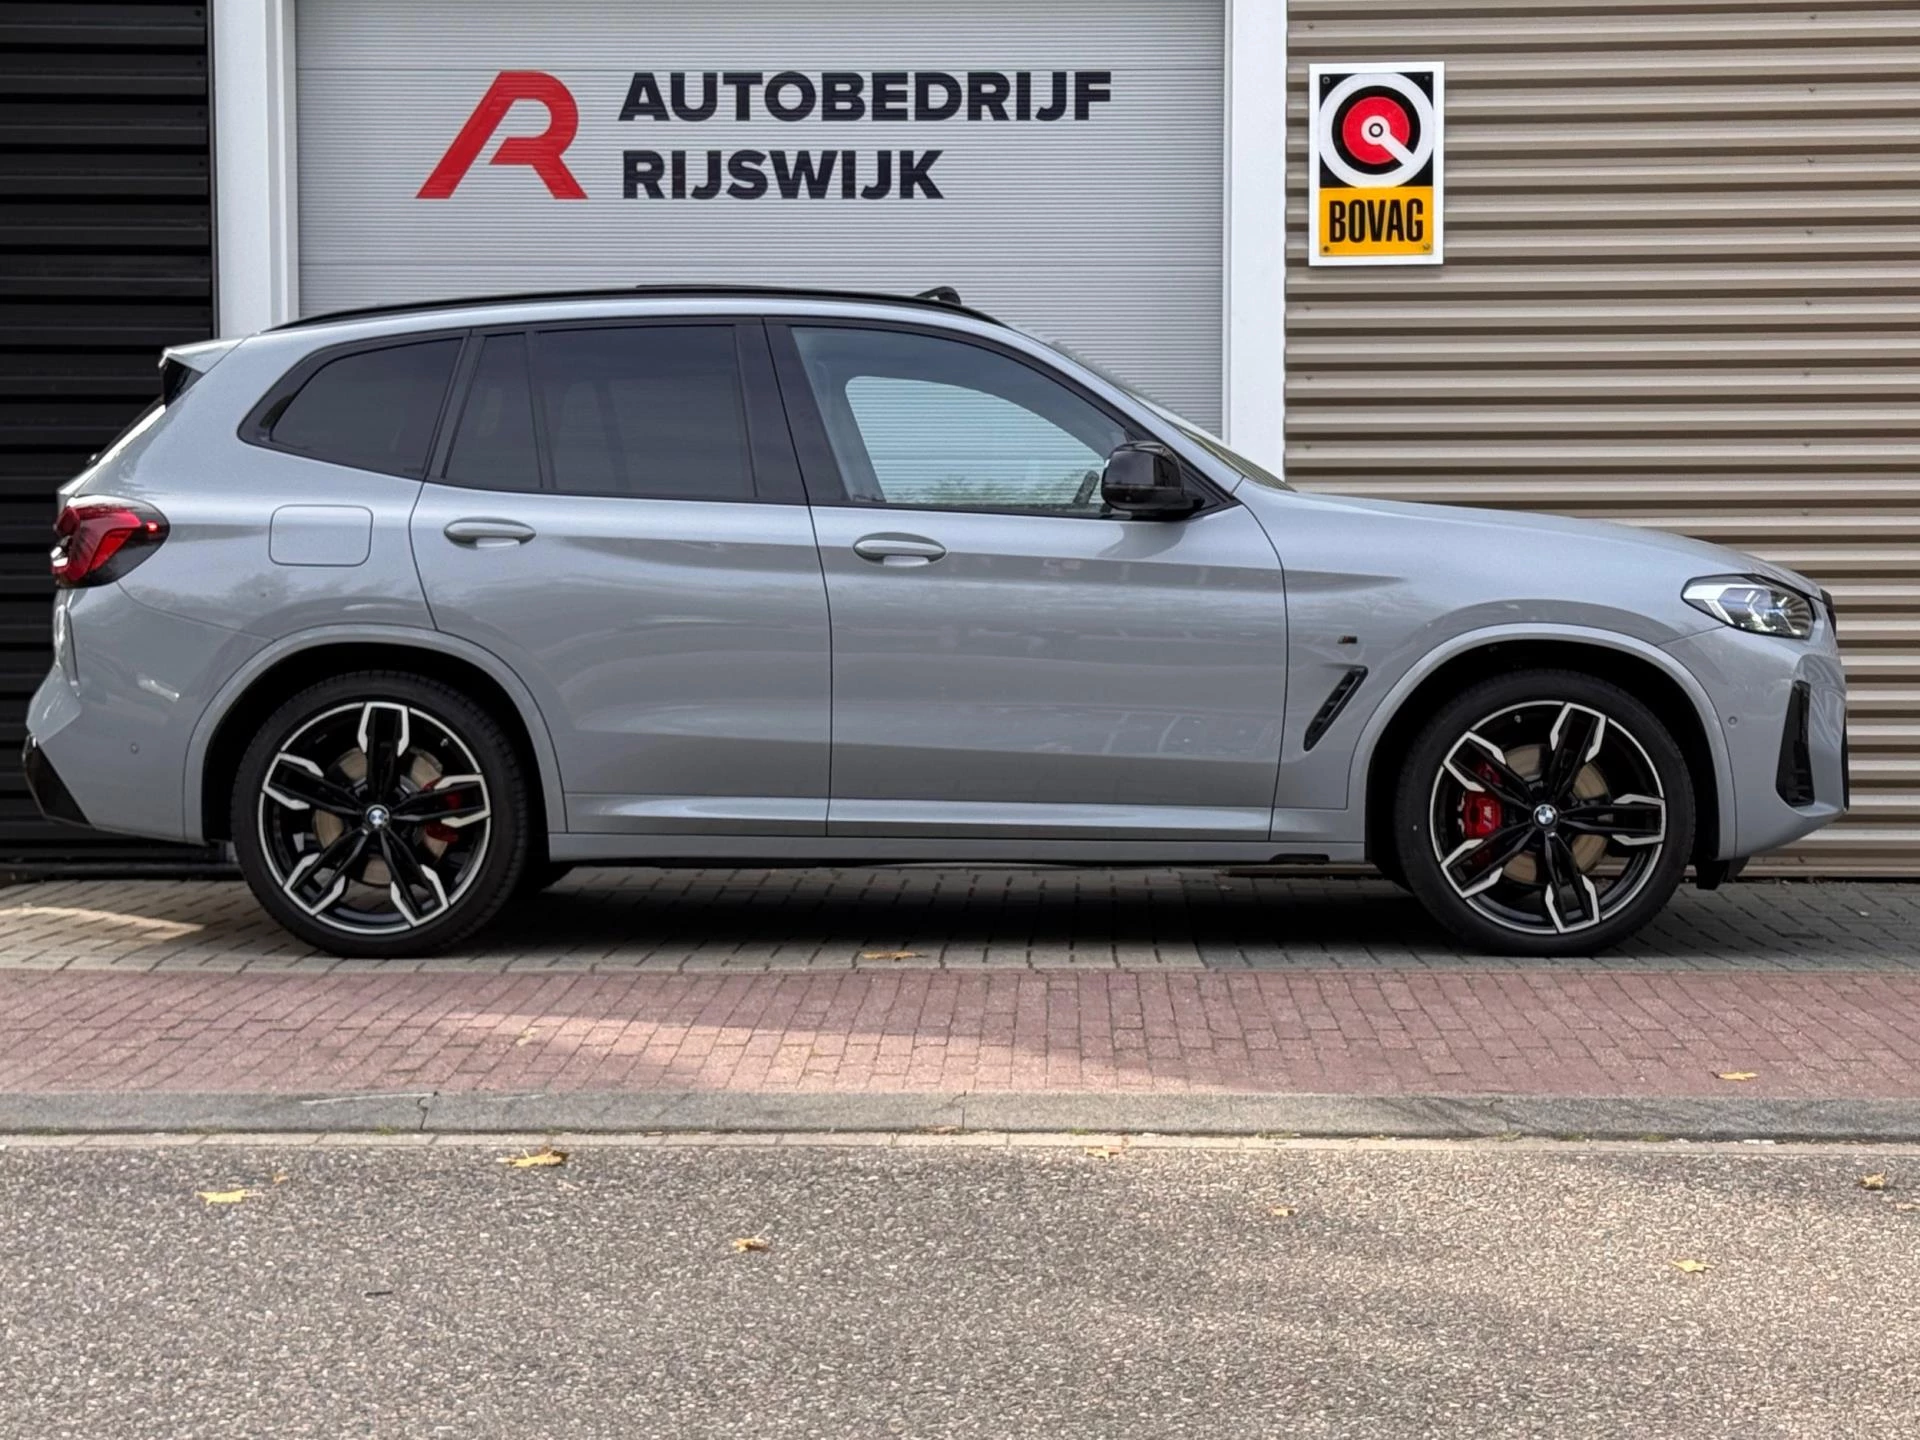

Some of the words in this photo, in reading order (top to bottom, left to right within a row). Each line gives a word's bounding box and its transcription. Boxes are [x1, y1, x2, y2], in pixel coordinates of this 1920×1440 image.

[618, 71, 1111, 122] AUTOBEDRIJF
[623, 150, 944, 199] RIJSWIJK
[1329, 198, 1424, 243] BOVAG
